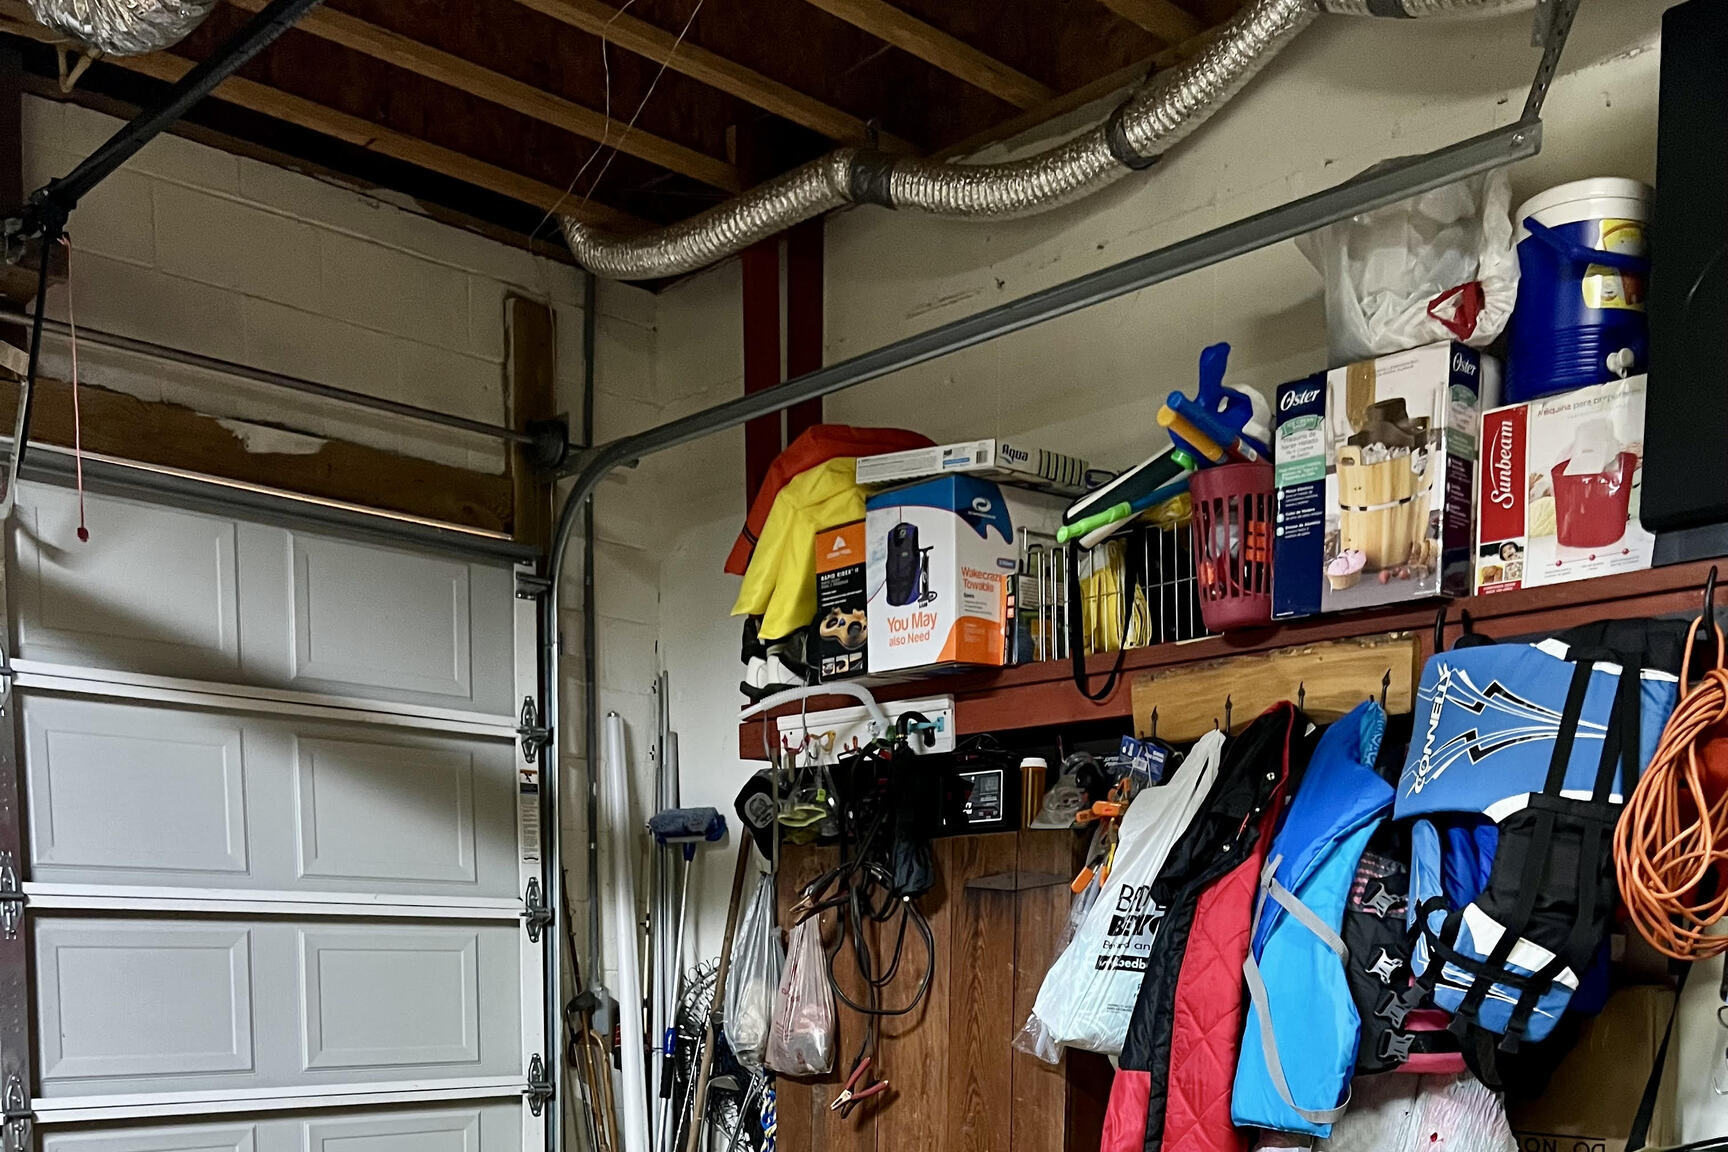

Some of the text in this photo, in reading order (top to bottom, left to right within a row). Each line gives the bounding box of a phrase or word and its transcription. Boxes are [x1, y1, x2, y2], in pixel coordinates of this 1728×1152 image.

[1452, 352, 1477, 376] Oster
[1280, 388, 1320, 411] Oster
[1002, 443, 1029, 462] Aqua
[1490, 420, 1514, 510] Sunbeam
[888, 612, 938, 633] You May
[888, 630, 930, 648] also Need
